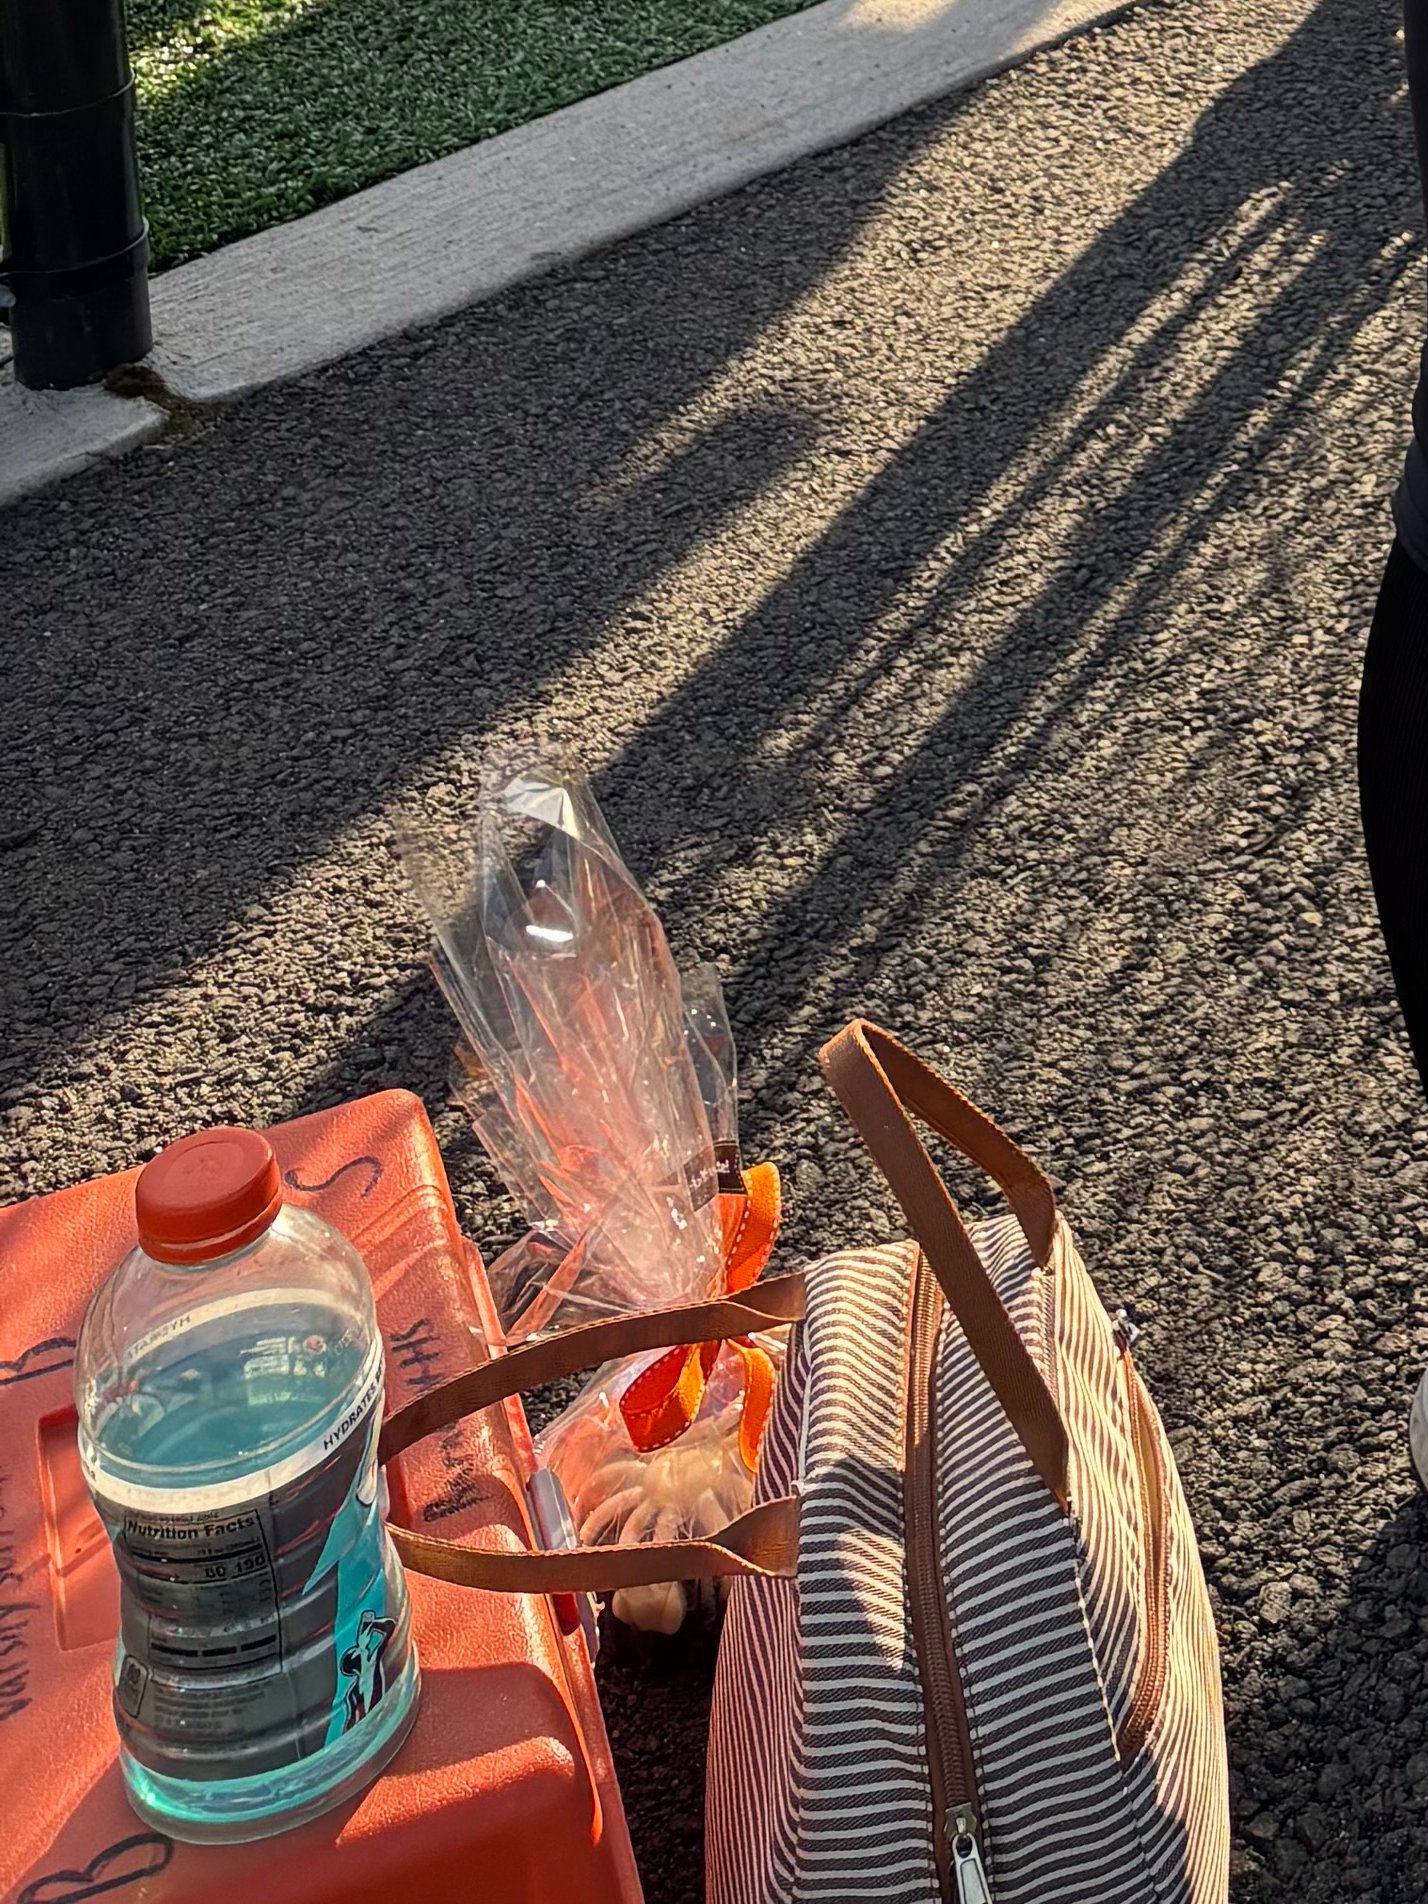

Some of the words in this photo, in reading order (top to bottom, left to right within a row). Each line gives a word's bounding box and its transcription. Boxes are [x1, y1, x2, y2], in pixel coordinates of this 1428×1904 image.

[323, 1382, 377, 1451] HYDRATES
[127, 1520, 199, 1540] Nutrition
[204, 1515, 256, 1537] Facts
